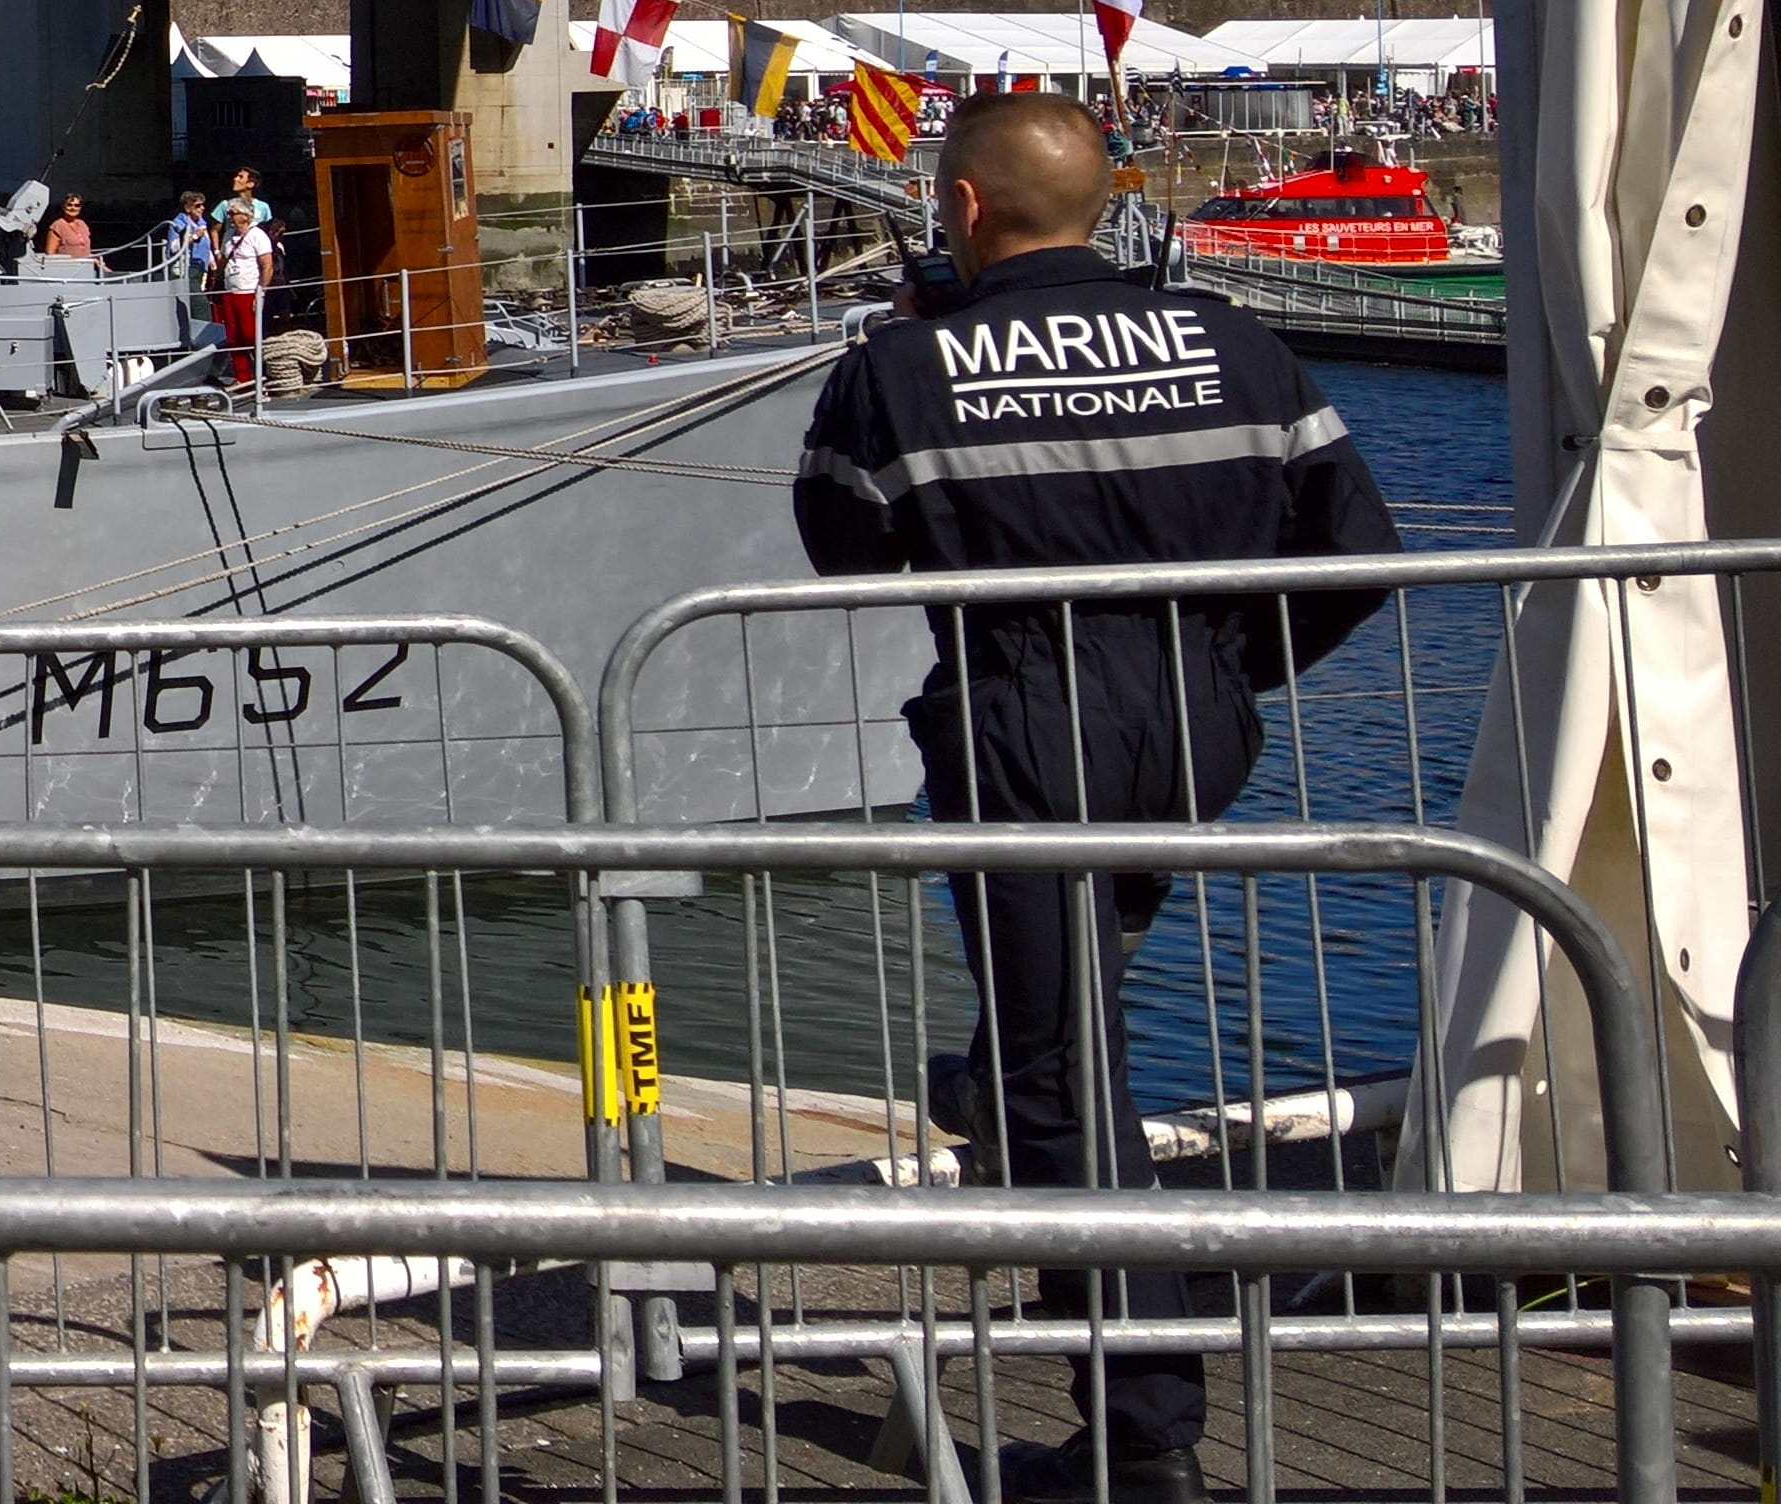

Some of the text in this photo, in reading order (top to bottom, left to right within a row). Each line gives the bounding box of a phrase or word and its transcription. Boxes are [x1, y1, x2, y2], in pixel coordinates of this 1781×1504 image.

[1299, 221, 1434, 233] LES SAUVETEURS EN MER
[936, 310, 1217, 377] MARINE
[953, 380, 1223, 423] NATIONALE
[32, 641, 409, 745] M652
[627, 1002, 656, 1097] TMF
